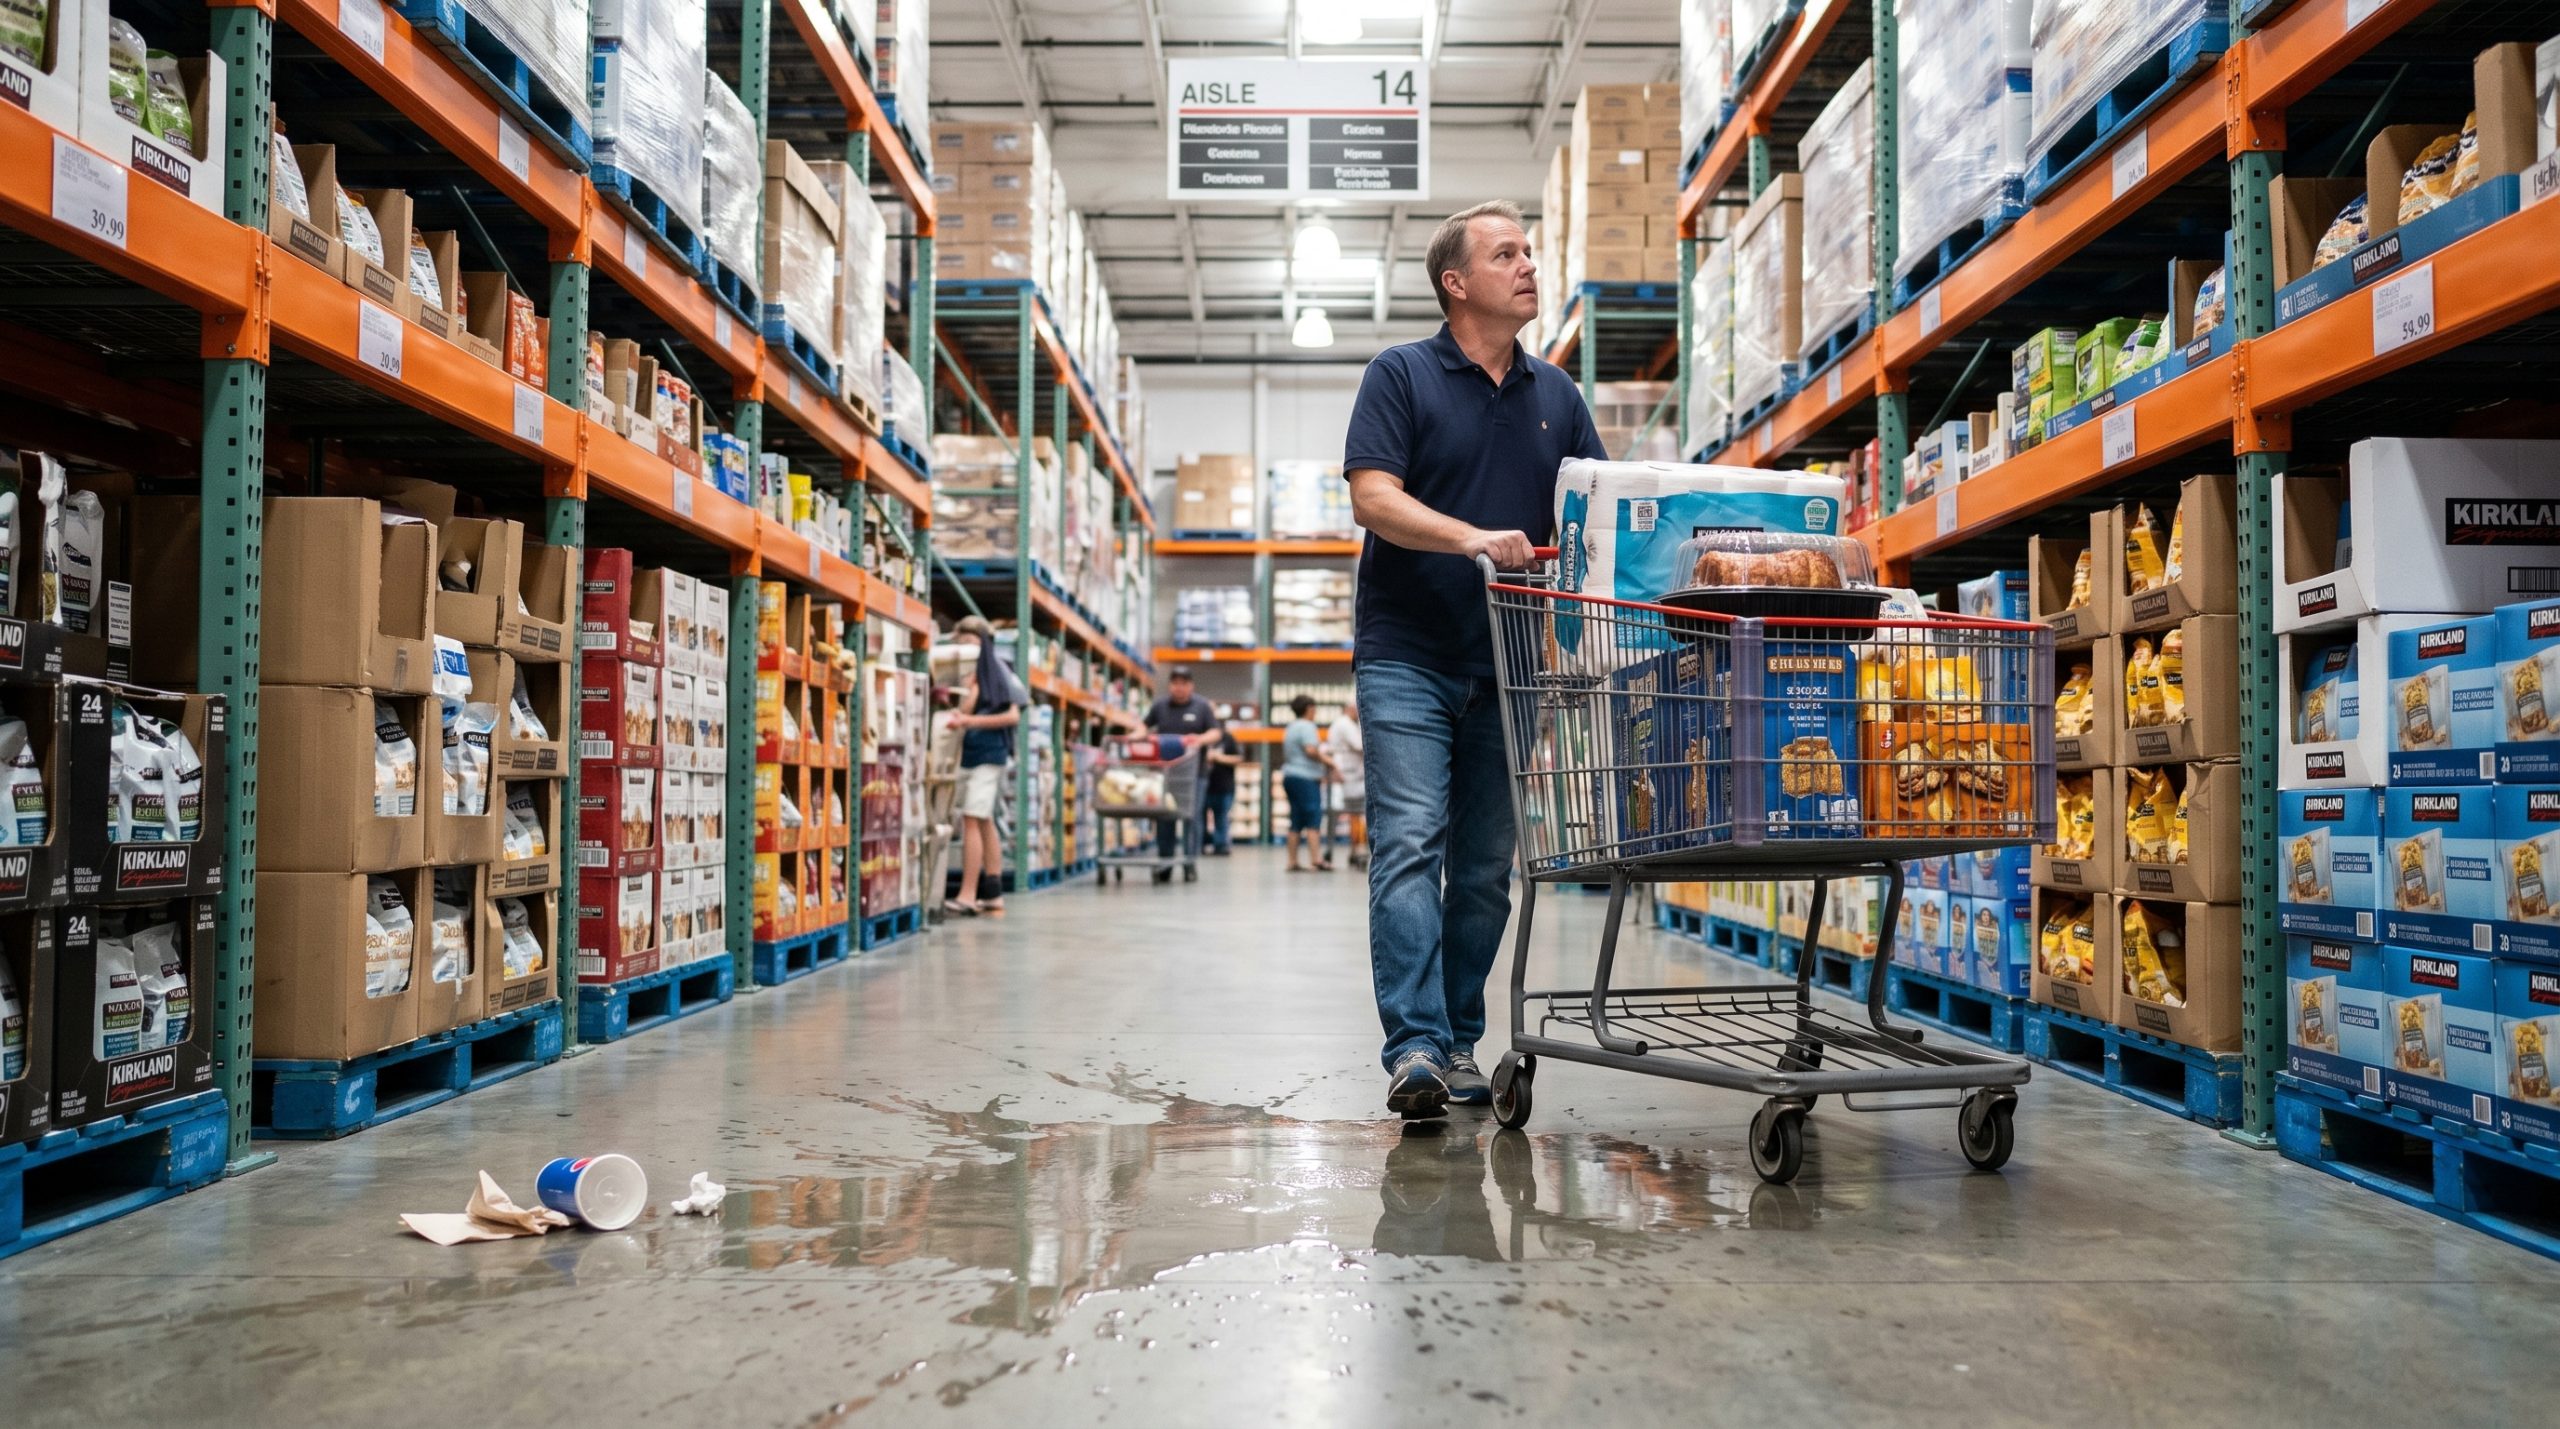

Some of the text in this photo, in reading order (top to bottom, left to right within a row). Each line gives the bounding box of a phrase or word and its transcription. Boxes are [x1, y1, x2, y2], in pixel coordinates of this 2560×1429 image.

[0, 68, 30, 98] AND
[1181, 70, 1417, 105] AISLE 14
[134, 140, 190, 184] KIRKLAND
[90, 208, 125, 241] 39.99
[2352, 236, 2400, 273] KIRKLAND
[81, 694, 103, 712] 24
[2413, 796, 2458, 810] KIRKLAND
[123, 850, 187, 870] KIRKLAND
[2412, 958, 2458, 978] KIRKLAND
[112, 1055, 174, 1086] KIRKLAND
